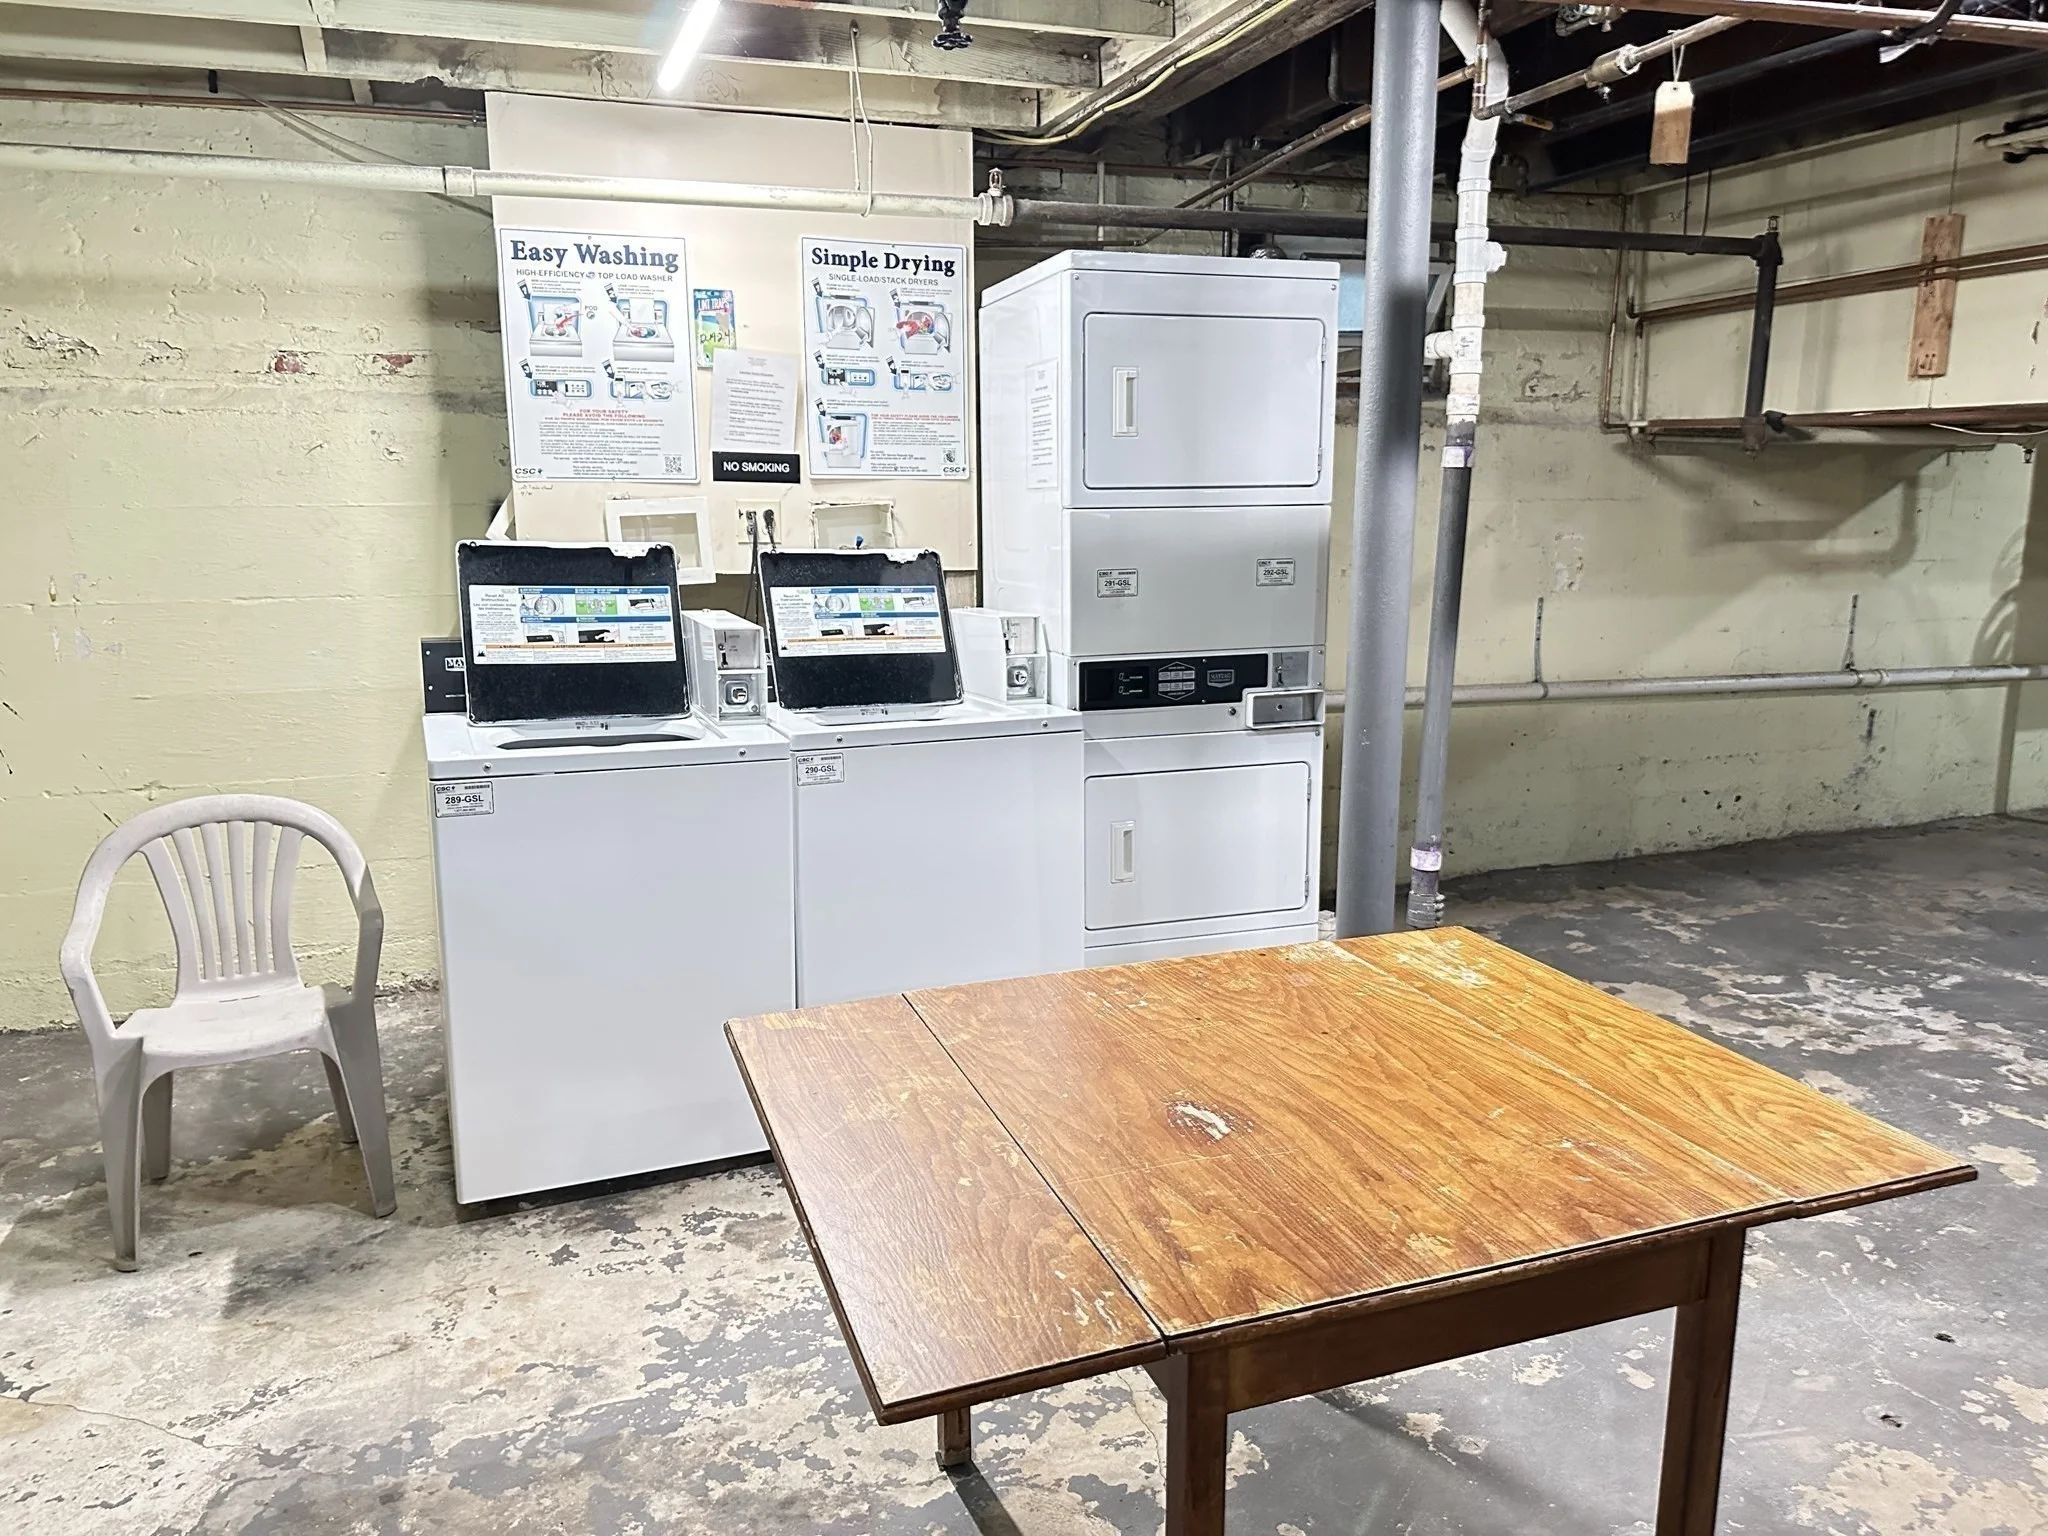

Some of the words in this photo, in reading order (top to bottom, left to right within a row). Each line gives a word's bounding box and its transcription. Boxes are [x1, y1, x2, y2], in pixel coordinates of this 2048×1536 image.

[510, 240, 568, 268] Easy
[574, 244, 679, 273] Washing
[812, 247, 878, 272] Simple
[884, 252, 956, 278] Drying
[516, 268, 584, 279] HIGH-EFFICIENCY
[723, 461, 740, 471] NO
[742, 462, 790, 473] SMOKING
[805, 765, 836, 773] 290-GSL
[445, 795, 484, 804] 289-GSL
